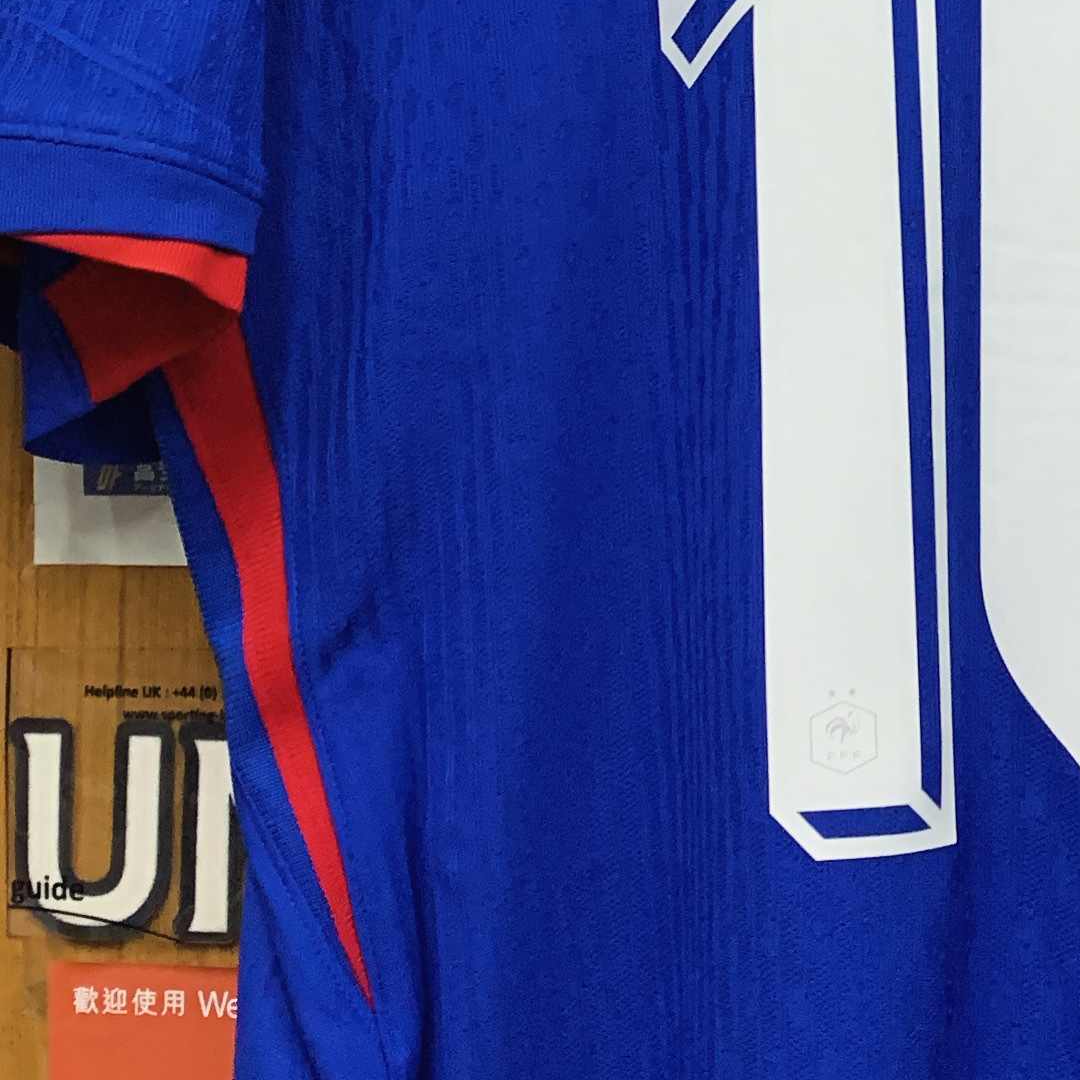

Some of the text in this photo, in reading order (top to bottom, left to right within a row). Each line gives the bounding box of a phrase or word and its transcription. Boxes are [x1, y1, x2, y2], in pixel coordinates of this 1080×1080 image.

[84, 685, 138, 701] Helpline
[142, 686, 161, 698] UK
[173, 686, 195, 698] +44
[12, 876, 84, 903] guide
[73, 986, 185, 1016] 歡迎使用
